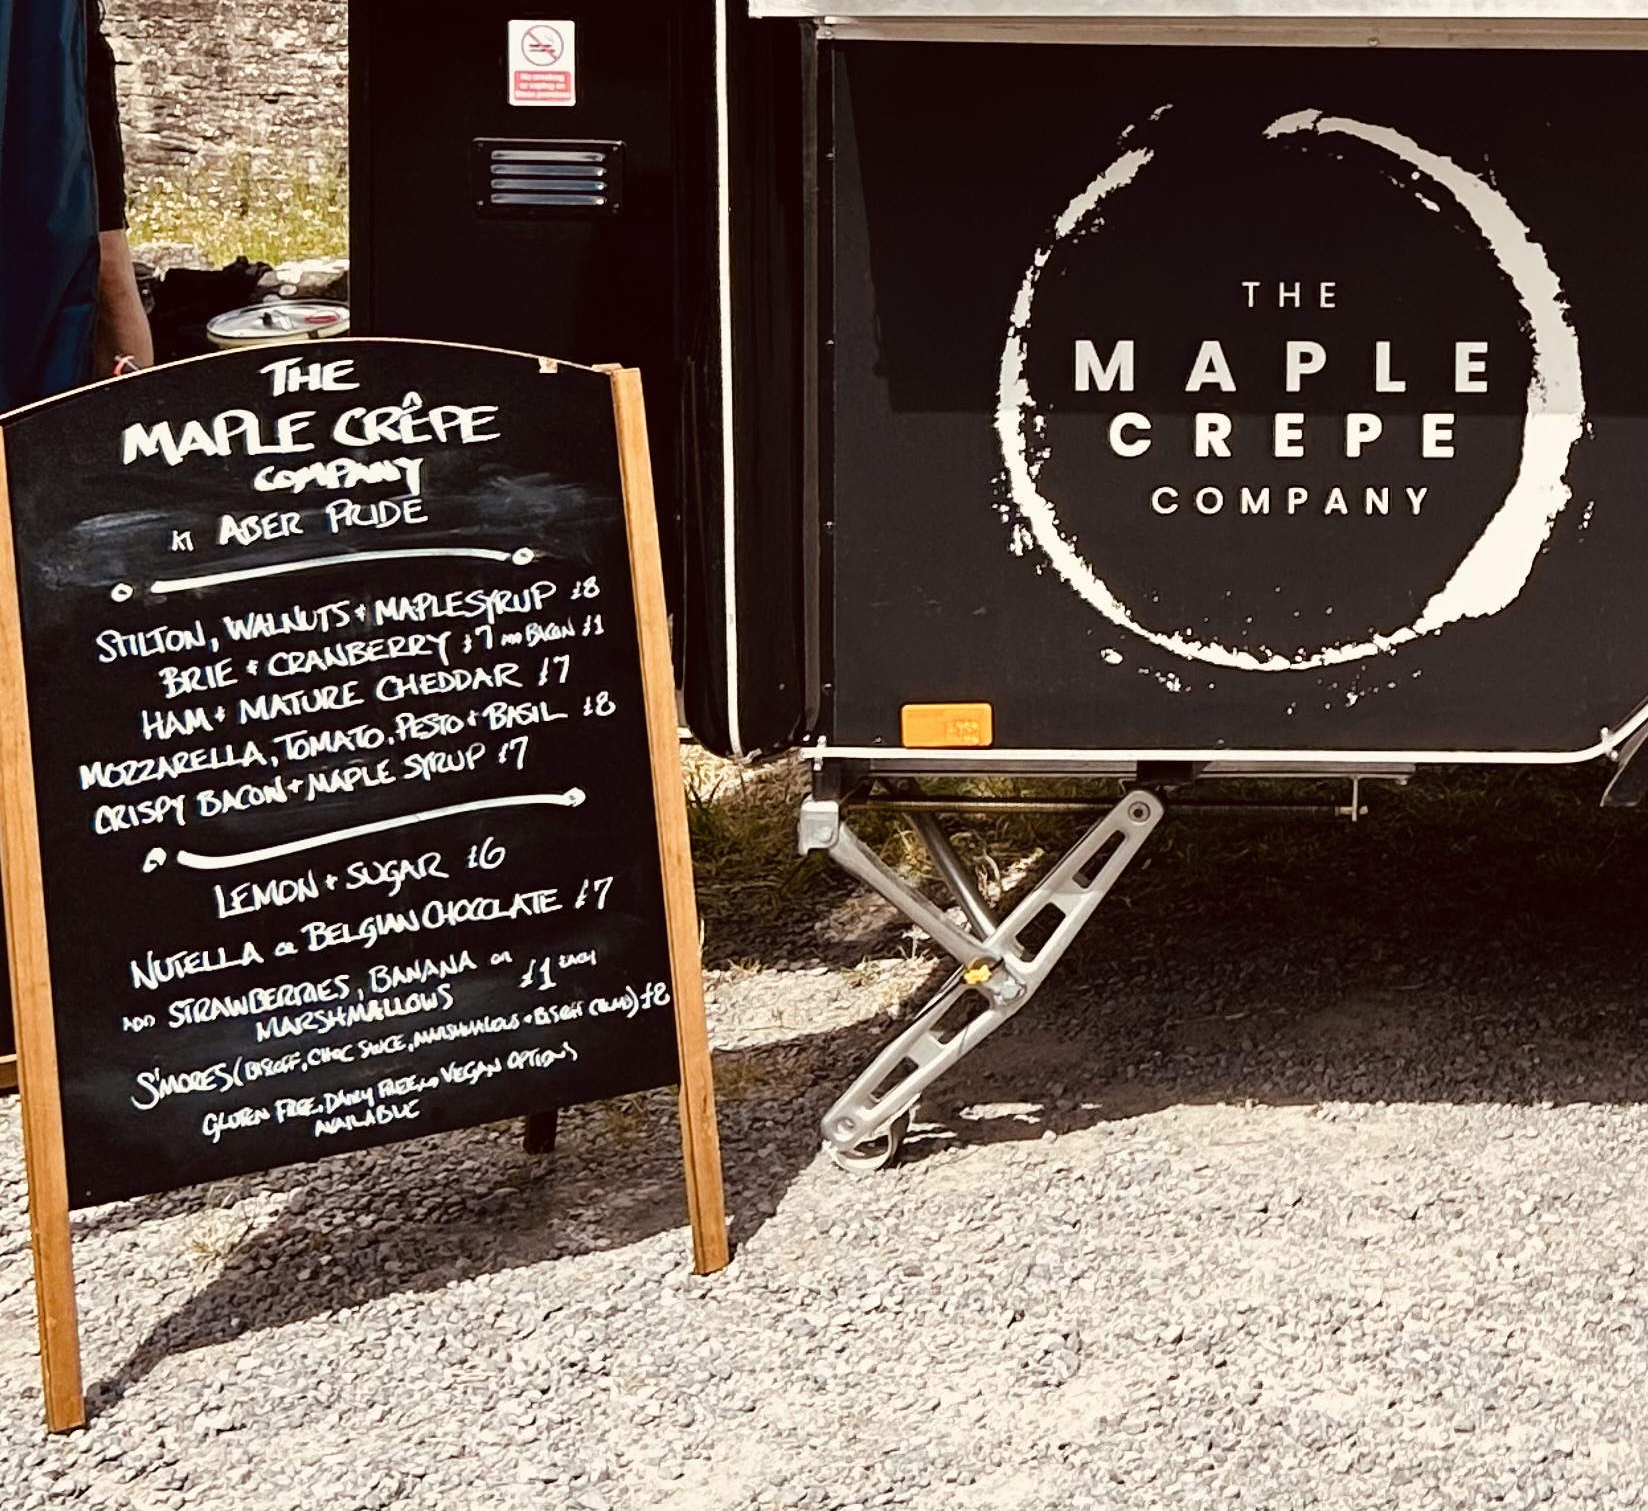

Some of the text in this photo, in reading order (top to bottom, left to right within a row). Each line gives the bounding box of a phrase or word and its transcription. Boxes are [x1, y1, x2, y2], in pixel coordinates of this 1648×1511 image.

[1242, 282, 1338, 308] THE
[260, 357, 360, 397] THE
[1074, 340, 1489, 392] MAPLE
[122, 391, 501, 466] MAPLE CRÊPE
[1108, 413, 1456, 458] CREPE
[253, 457, 425, 497] COMPANY
[1151, 486, 1429, 515] COMPANY
[217, 509, 303, 545] ABER
[326, 498, 428, 533] PRIDE
[96, 620, 220, 663] STILTON,
[221, 601, 350, 641] WALNUTS
[571, 575, 601, 599] £8
[159, 658, 238, 699] BRIE
[267, 631, 452, 676] CRANBERRY
[463, 625, 494, 654] £7
[525, 616, 575, 647] BACON
[582, 614, 605, 637] £1
[141, 707, 214, 740] HAM
[238, 681, 365, 724] MATURE
[375, 663, 523, 702] CHEDDAR
[538, 654, 570, 686] £7
[79, 741, 279, 790] MOZZARELLA,
[396, 712, 464, 741] PESTO
[481, 701, 568, 731] BASIL
[583, 691, 617, 717] £8
[94, 793, 186, 835] CRISPY
[196, 776, 288, 817] BACON
[305, 759, 396, 801] MAPLE
[403, 742, 486, 781] SYRUP
[498, 736, 528, 770] £7
[213, 870, 319, 919] LEMON
[346, 852, 449, 897] SUGAR
[466, 837, 506, 870] £6
[130, 941, 264, 990] NUTELLA
[300, 910, 420, 952] BELGIAN
[421, 889, 563, 929] CHOCOLATE
[575, 876, 614, 910] £7
[368, 950, 477, 991] BANANA
[256, 983, 454, 1042] MARSHMALLOWS
[131, 1067, 234, 1111] S'MORES
[306, 1044, 355, 1066] CHOC
[202, 1106, 271, 1144] GLUTEN
[323, 1086, 375, 1115] DAIRY
[440, 1057, 502, 1084] VEGAN
[506, 1041, 578, 1070] OPTIONS
